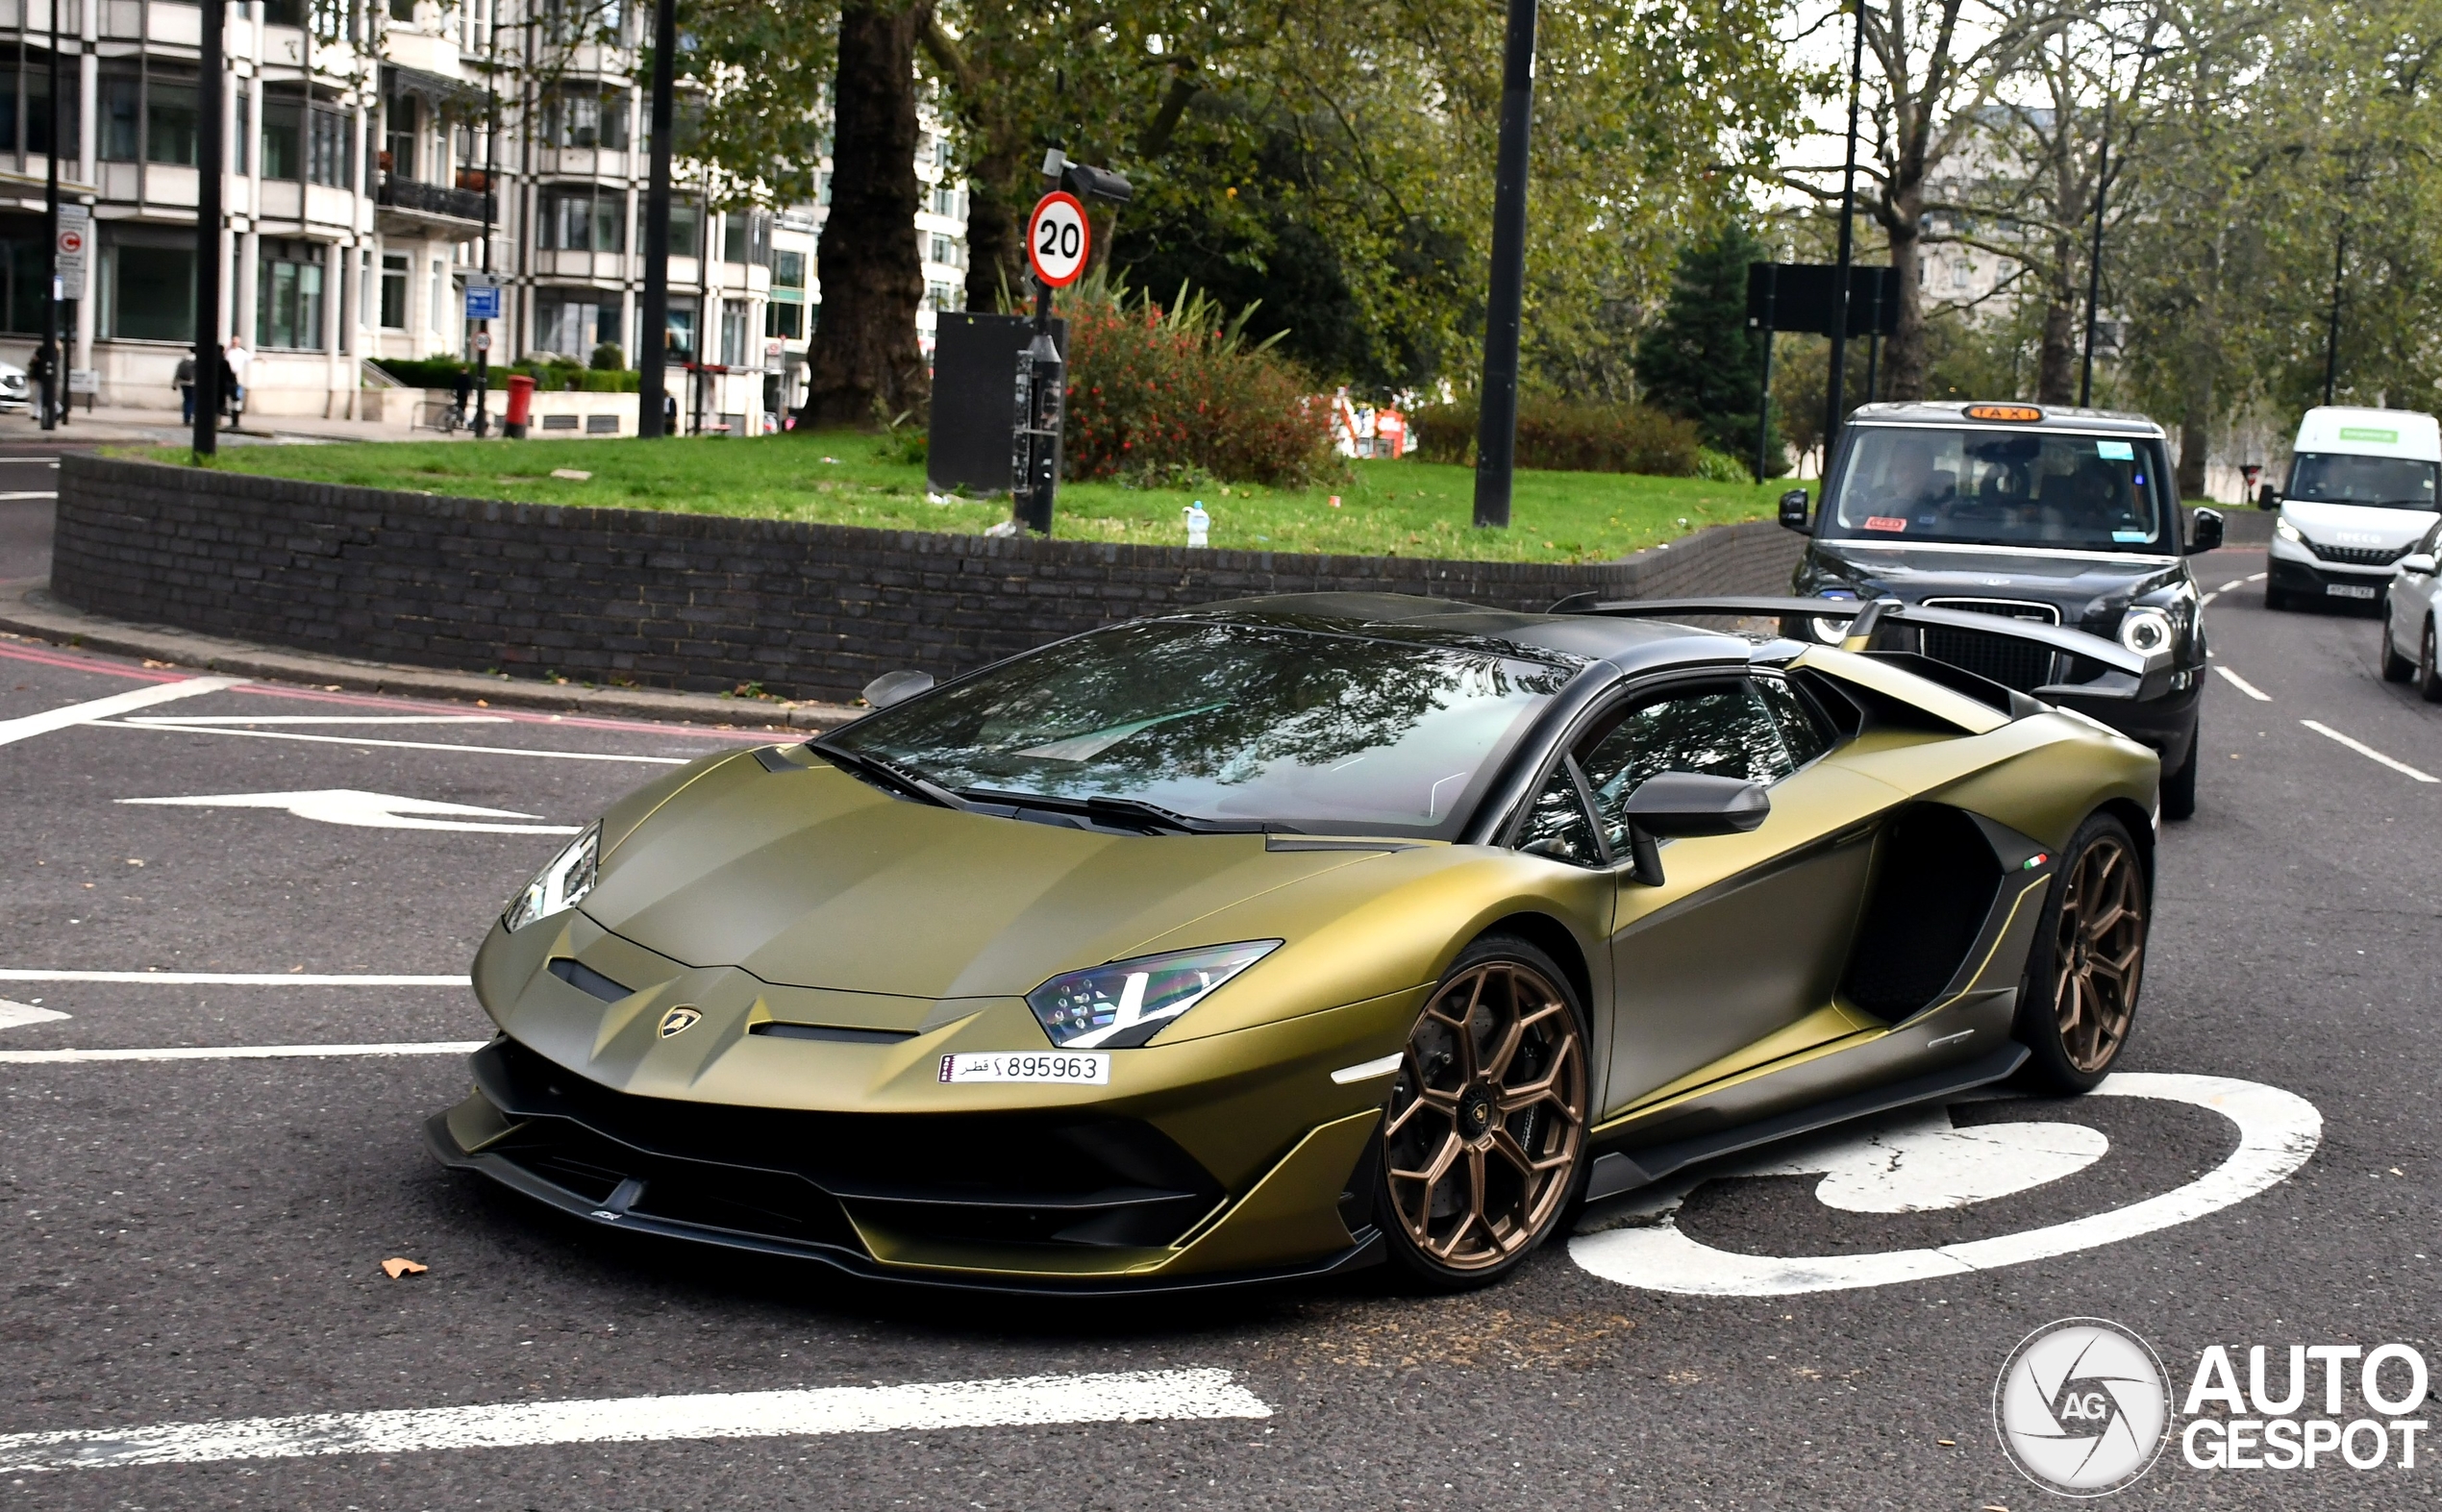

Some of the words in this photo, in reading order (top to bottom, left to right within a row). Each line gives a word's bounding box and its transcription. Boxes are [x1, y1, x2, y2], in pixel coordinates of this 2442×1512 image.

[1039, 219, 1080, 259] 20
[1977, 408, 2032, 419] TAXI
[2336, 532, 2381, 544] IVECO
[959, 1059, 989, 1076] قطر
[1008, 1057, 1098, 1079] 895963
